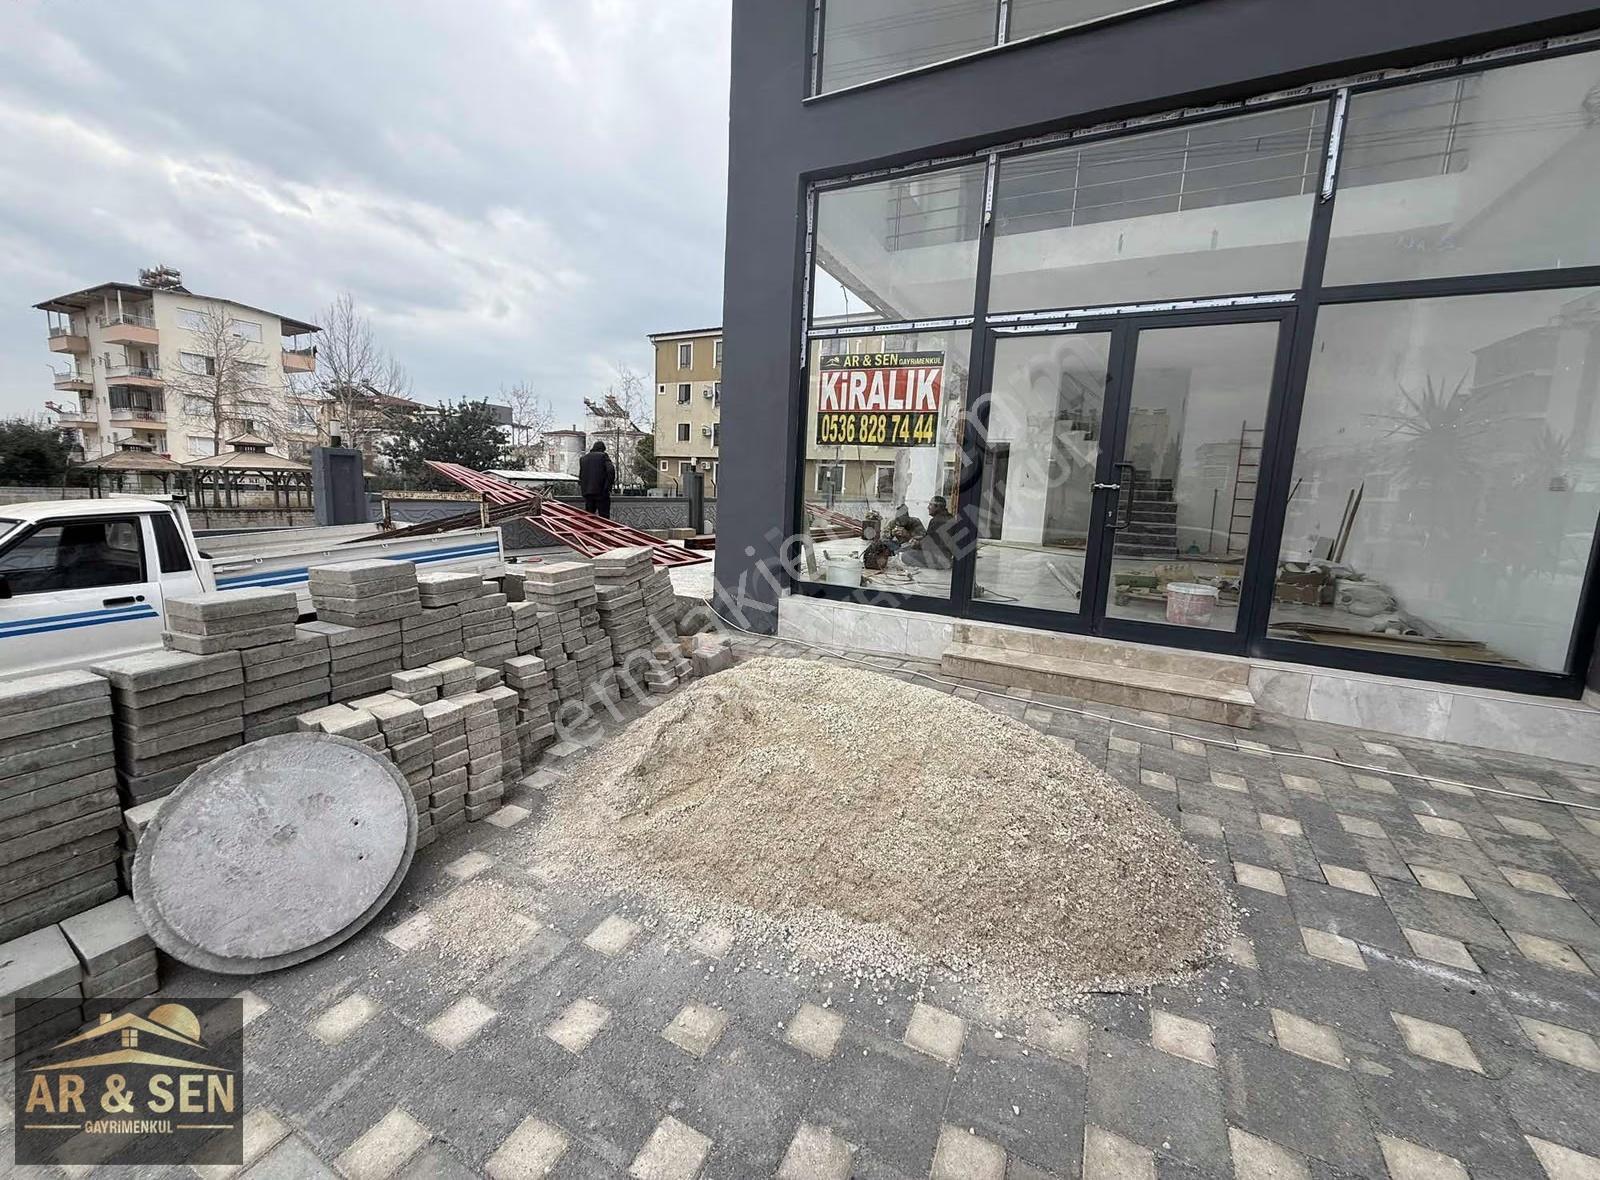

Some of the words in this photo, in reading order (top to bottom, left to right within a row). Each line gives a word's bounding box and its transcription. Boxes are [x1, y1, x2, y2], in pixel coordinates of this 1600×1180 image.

[843, 356, 860, 368] AR
[862, 354, 872, 366] &
[874, 353, 899, 366] SEN
[821, 414, 855, 443] 0536
[859, 414, 887, 443] 828
[891, 414, 909, 443] 74
[913, 413, 934, 443] 44
